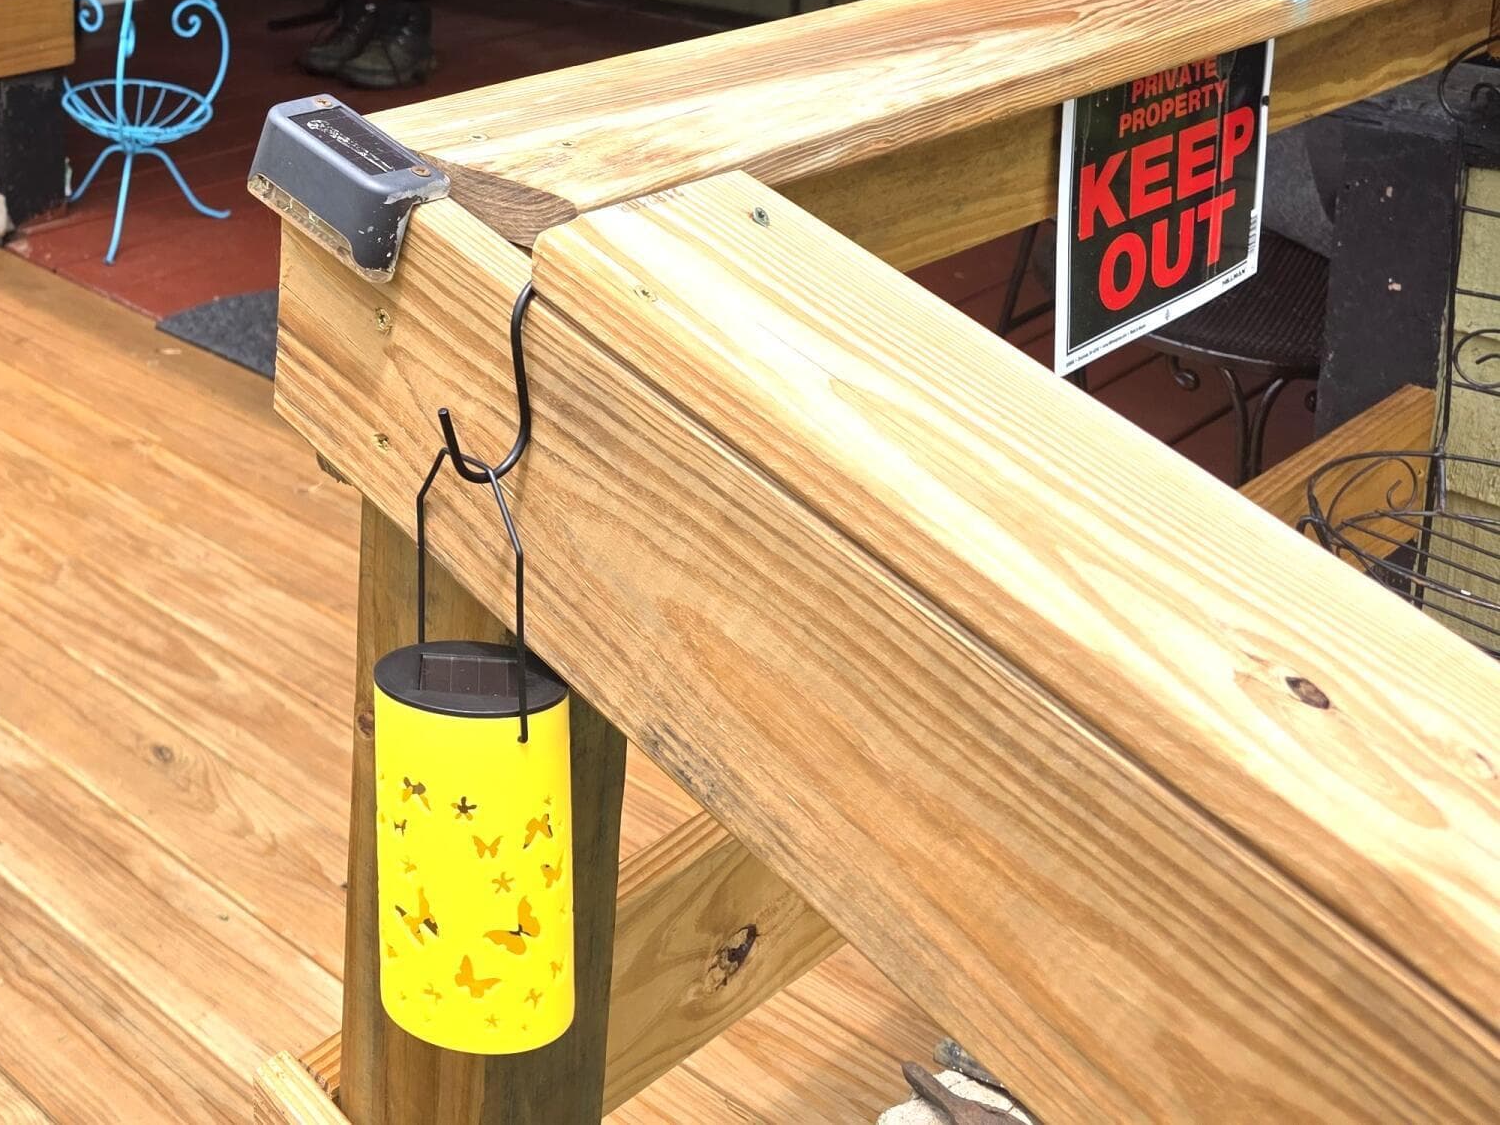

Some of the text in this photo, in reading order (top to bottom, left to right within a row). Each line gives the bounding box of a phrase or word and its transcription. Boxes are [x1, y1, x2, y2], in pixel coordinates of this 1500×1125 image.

[1119, 80, 1227, 138] PROPERTY
[1131, 57, 1218, 103] PRIVATE
[1078, 106, 1255, 242] KEEP
[1099, 189, 1236, 311] OUT
